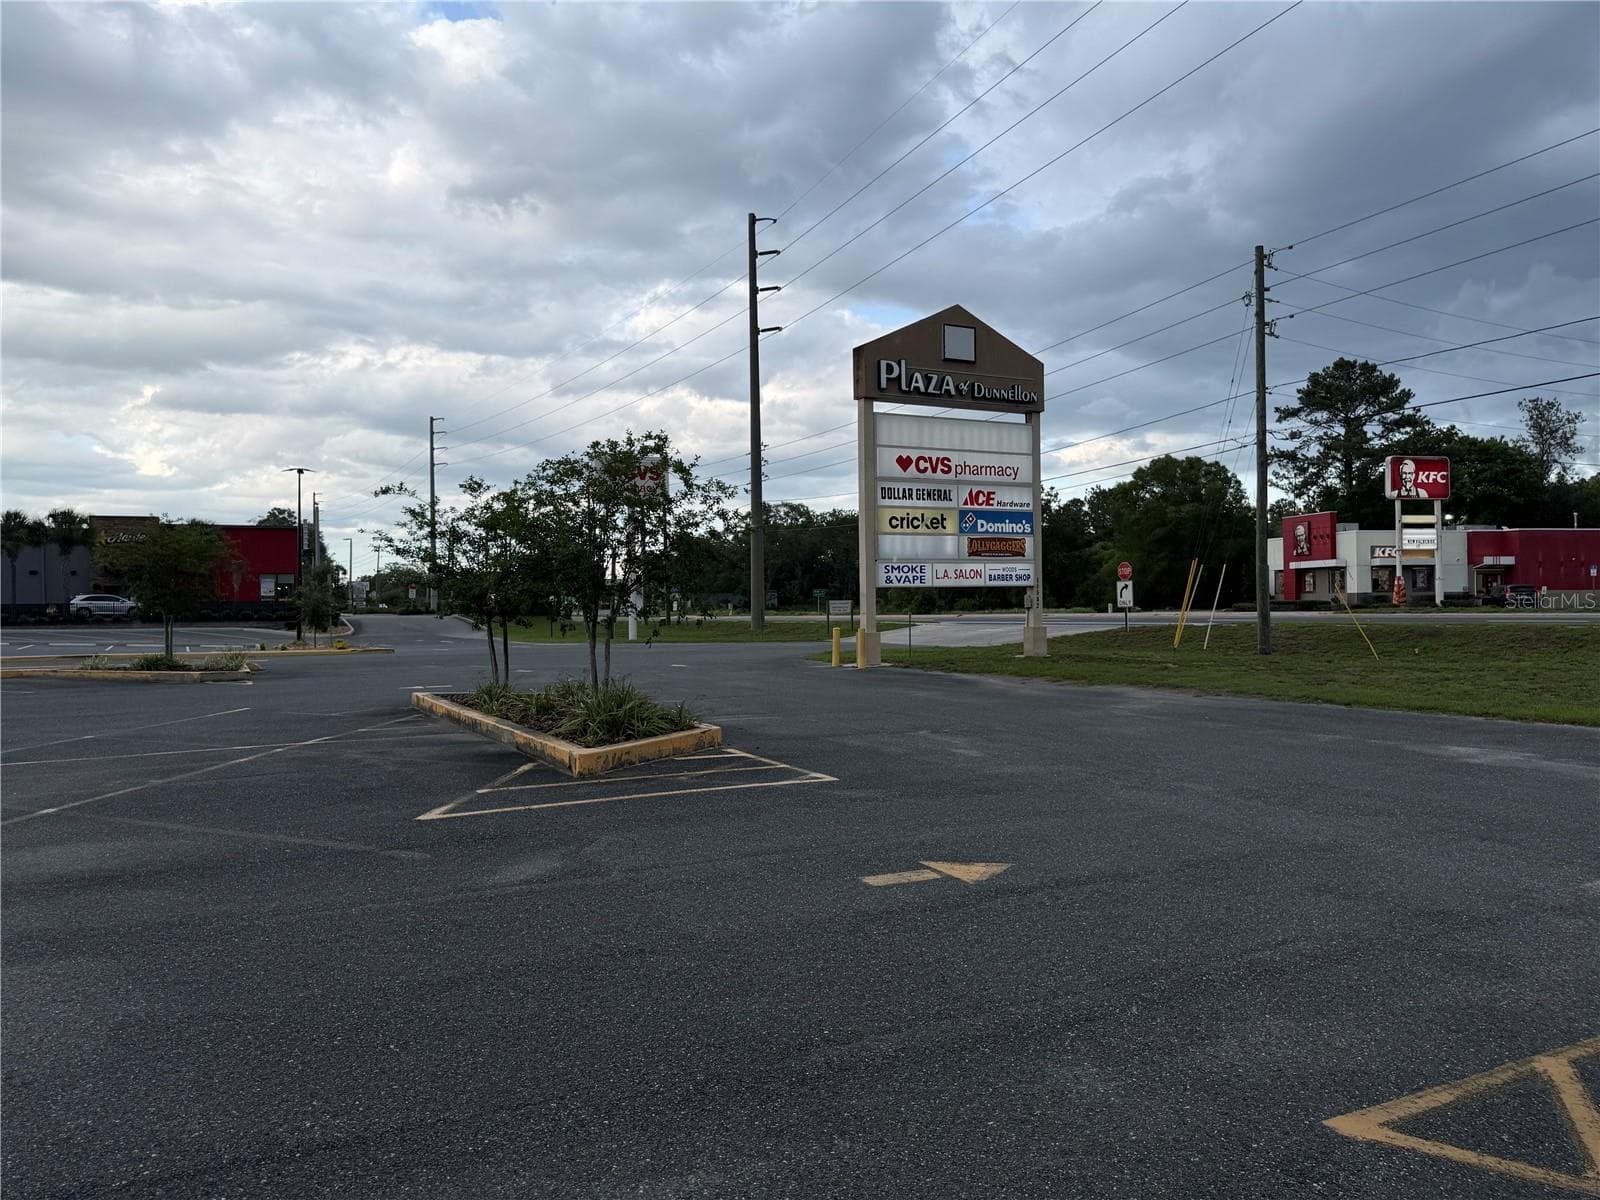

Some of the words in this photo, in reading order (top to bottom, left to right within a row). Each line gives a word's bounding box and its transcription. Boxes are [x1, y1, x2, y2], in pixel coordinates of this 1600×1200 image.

[958, 380, 970, 395] of
[914, 455, 952, 475] CVS
[955, 460, 1019, 480] pharmacy
[1417, 471, 1447, 483] KFC
[880, 487, 914, 501] DOLLAR
[915, 488, 953, 502] GENERAL
[962, 487, 996, 507] ACE
[996, 500, 1031, 508] Hardware
[888, 513, 947, 530] cricket
[977, 519, 1031, 534] Domino's
[884, 564, 927, 575] SMOKE
[935, 568, 952, 580] L.A.
[953, 568, 983, 580] SALON
[895, 574, 926, 585] VAPE
[988, 573, 1014, 582] BARBER
[1015, 573, 1031, 582] SHOP
